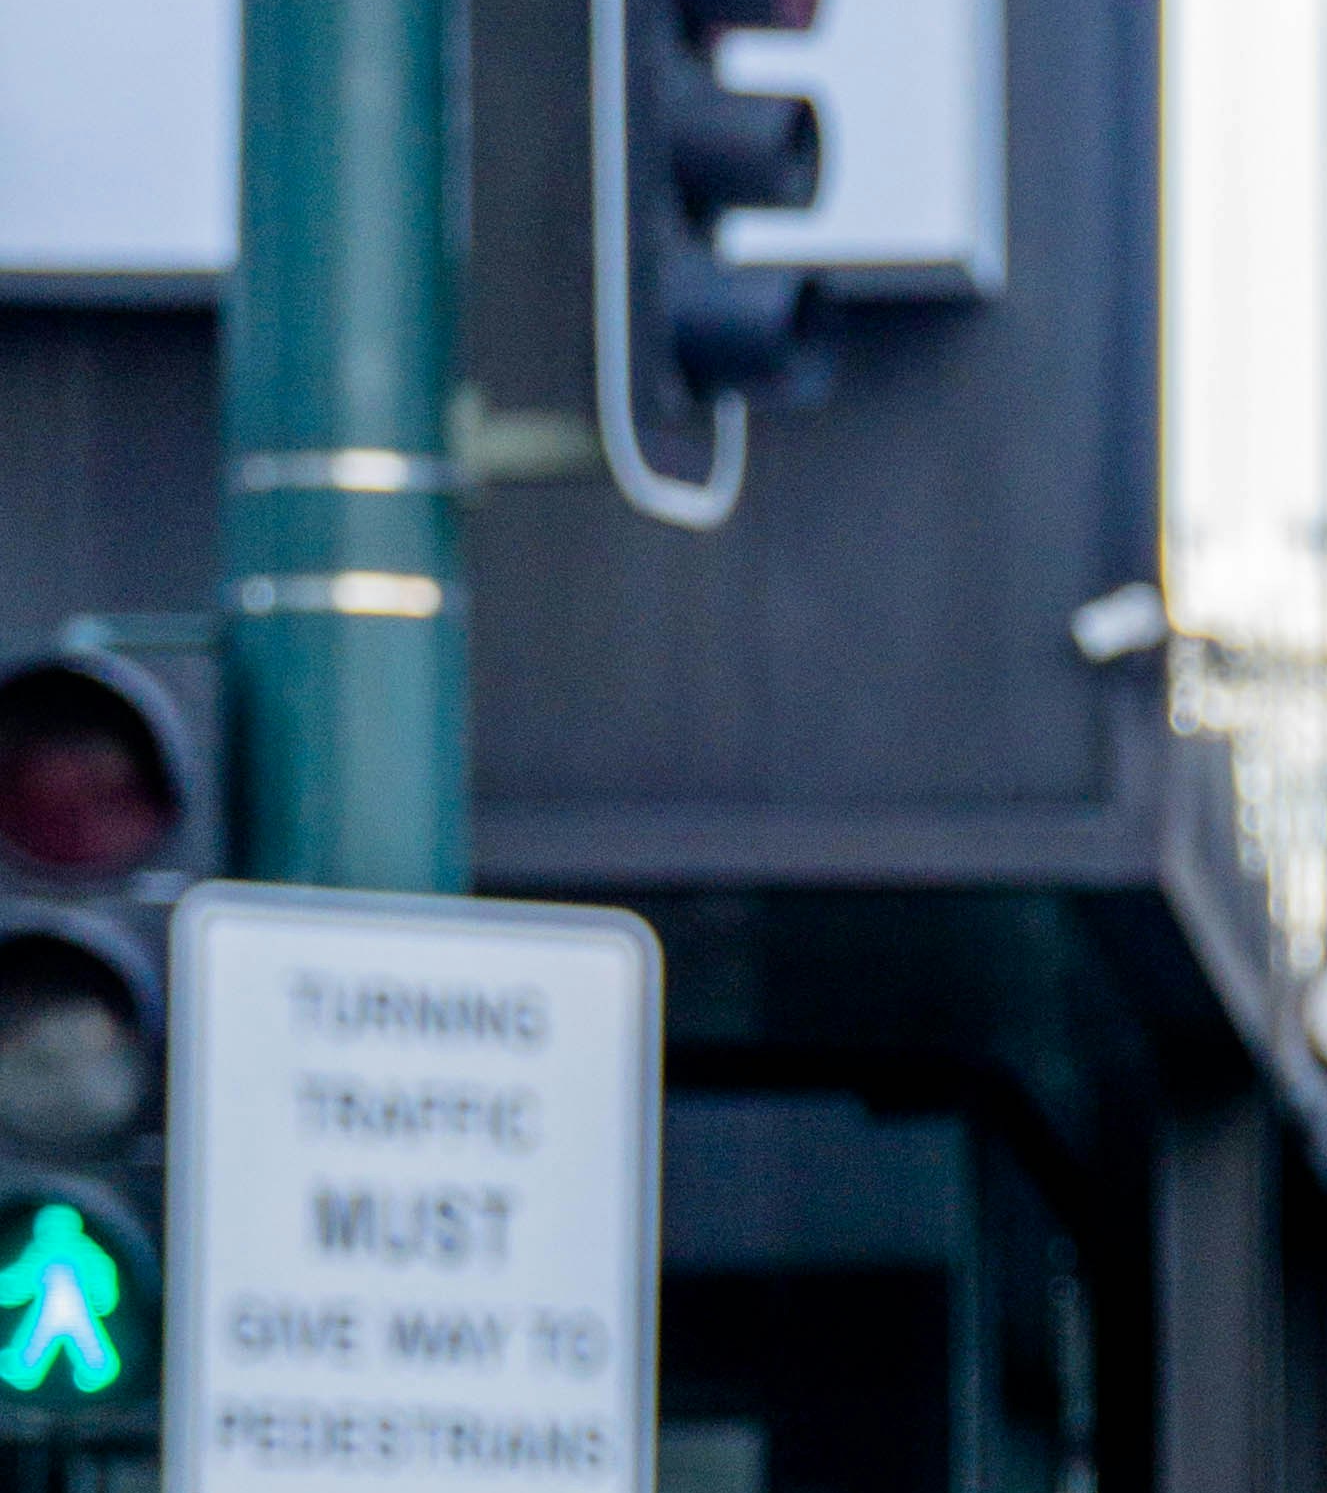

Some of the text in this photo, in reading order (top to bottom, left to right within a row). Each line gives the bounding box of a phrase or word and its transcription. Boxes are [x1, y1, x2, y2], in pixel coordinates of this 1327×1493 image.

[300, 1079, 538, 1150] TRAFFIC
[308, 1179, 516, 1266] MUST
[530, 1311, 609, 1375] TO
